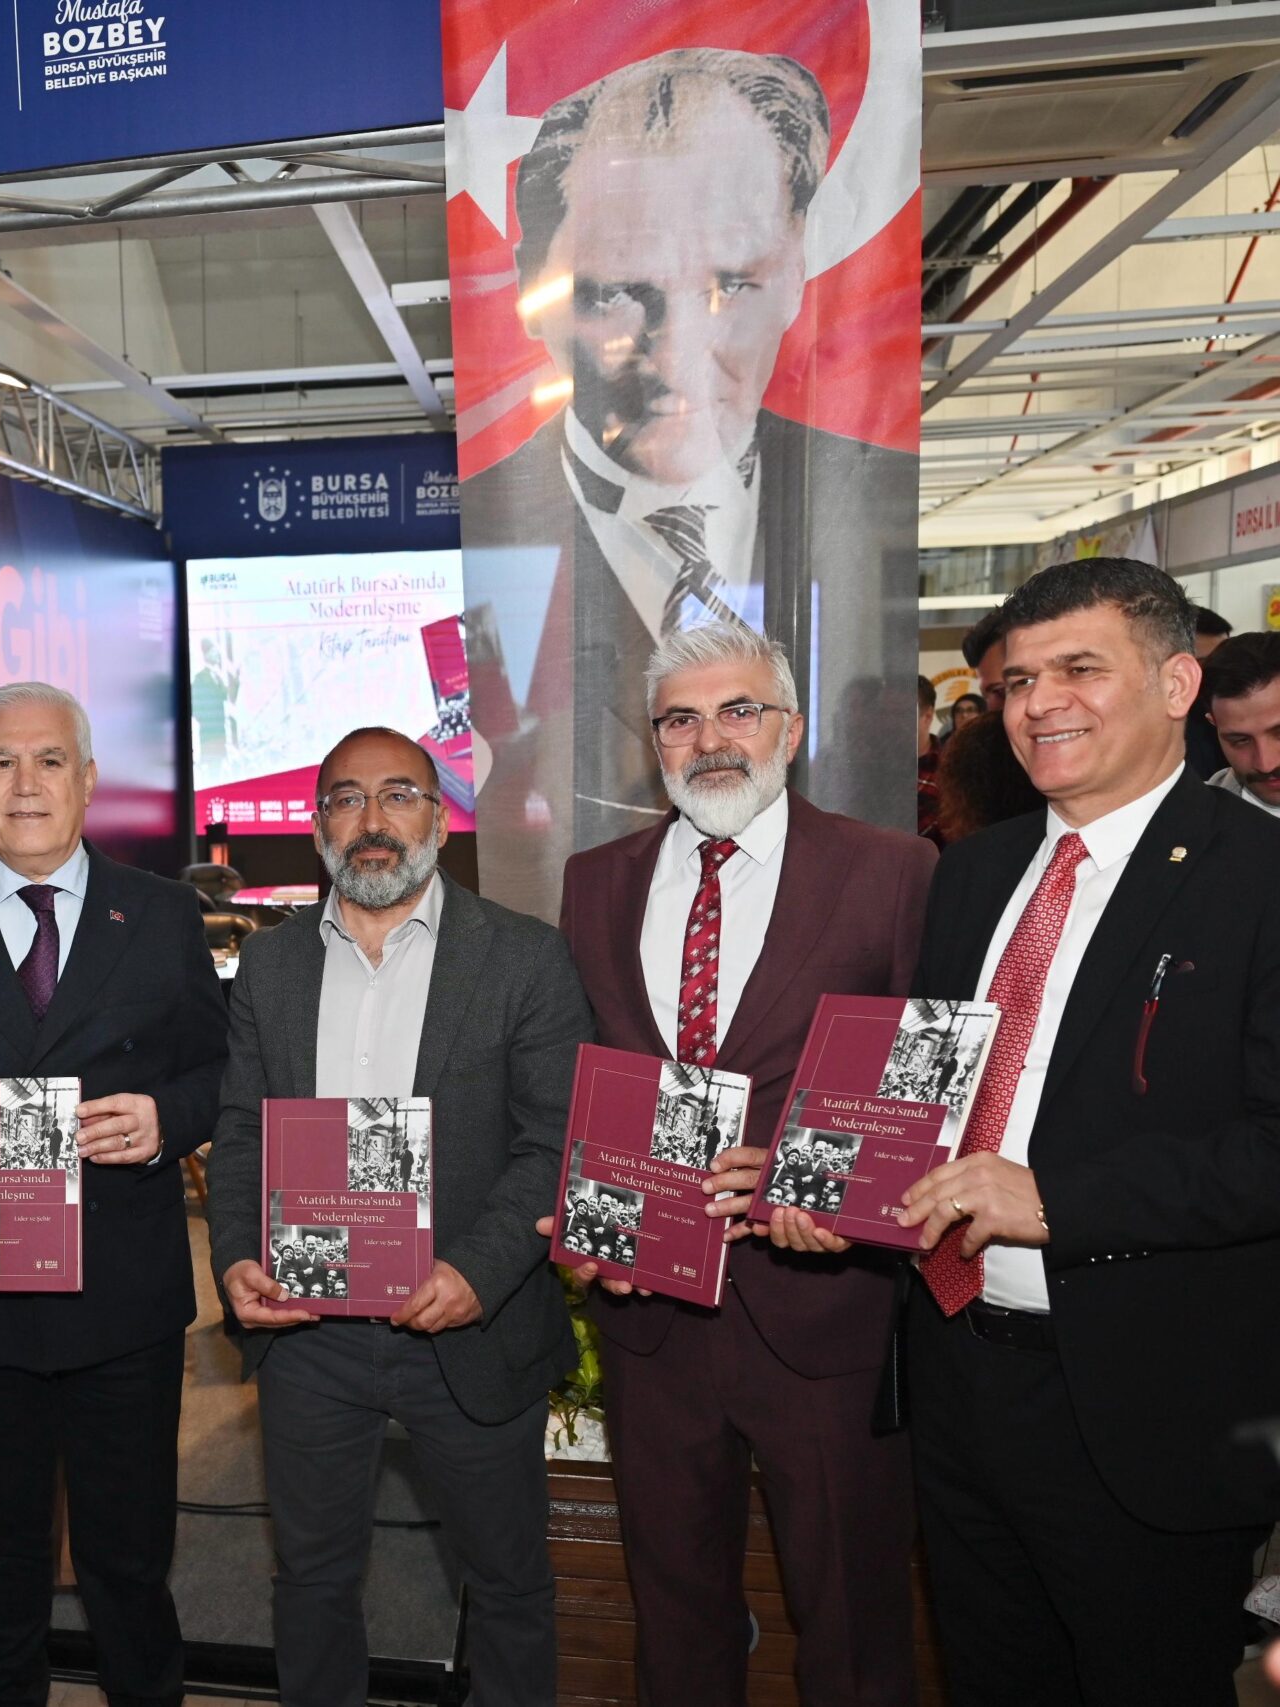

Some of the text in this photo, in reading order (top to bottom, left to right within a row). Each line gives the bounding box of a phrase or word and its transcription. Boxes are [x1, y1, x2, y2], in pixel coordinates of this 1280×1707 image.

[55, 0, 145, 26] Mustafa
[43, 16, 166, 57] BOZBEY
[44, 49, 167, 77] BURSA BÜYÜKŞEHİR
[45, 63, 168, 91] BELEDİYE BAŞKANI
[311, 472, 389, 493] BURSA
[311, 490, 389, 507] BÜYÜKŞEHİR
[311, 503, 390, 520] BELEDİYESİ
[1236, 505, 1264, 538] BURSA
[287, 575, 345, 596] Atatürk
[309, 597, 422, 622] Modernleşme
[820, 1096, 860, 1111] Atatürk
[830, 1116, 905, 1136] Modernleşme
[597, 1150, 637, 1170] Atatürk
[610, 1171, 683, 1199] Modernleşme
[296, 1194, 337, 1206] Atatürk
[312, 1211, 385, 1225] Modernleşme
